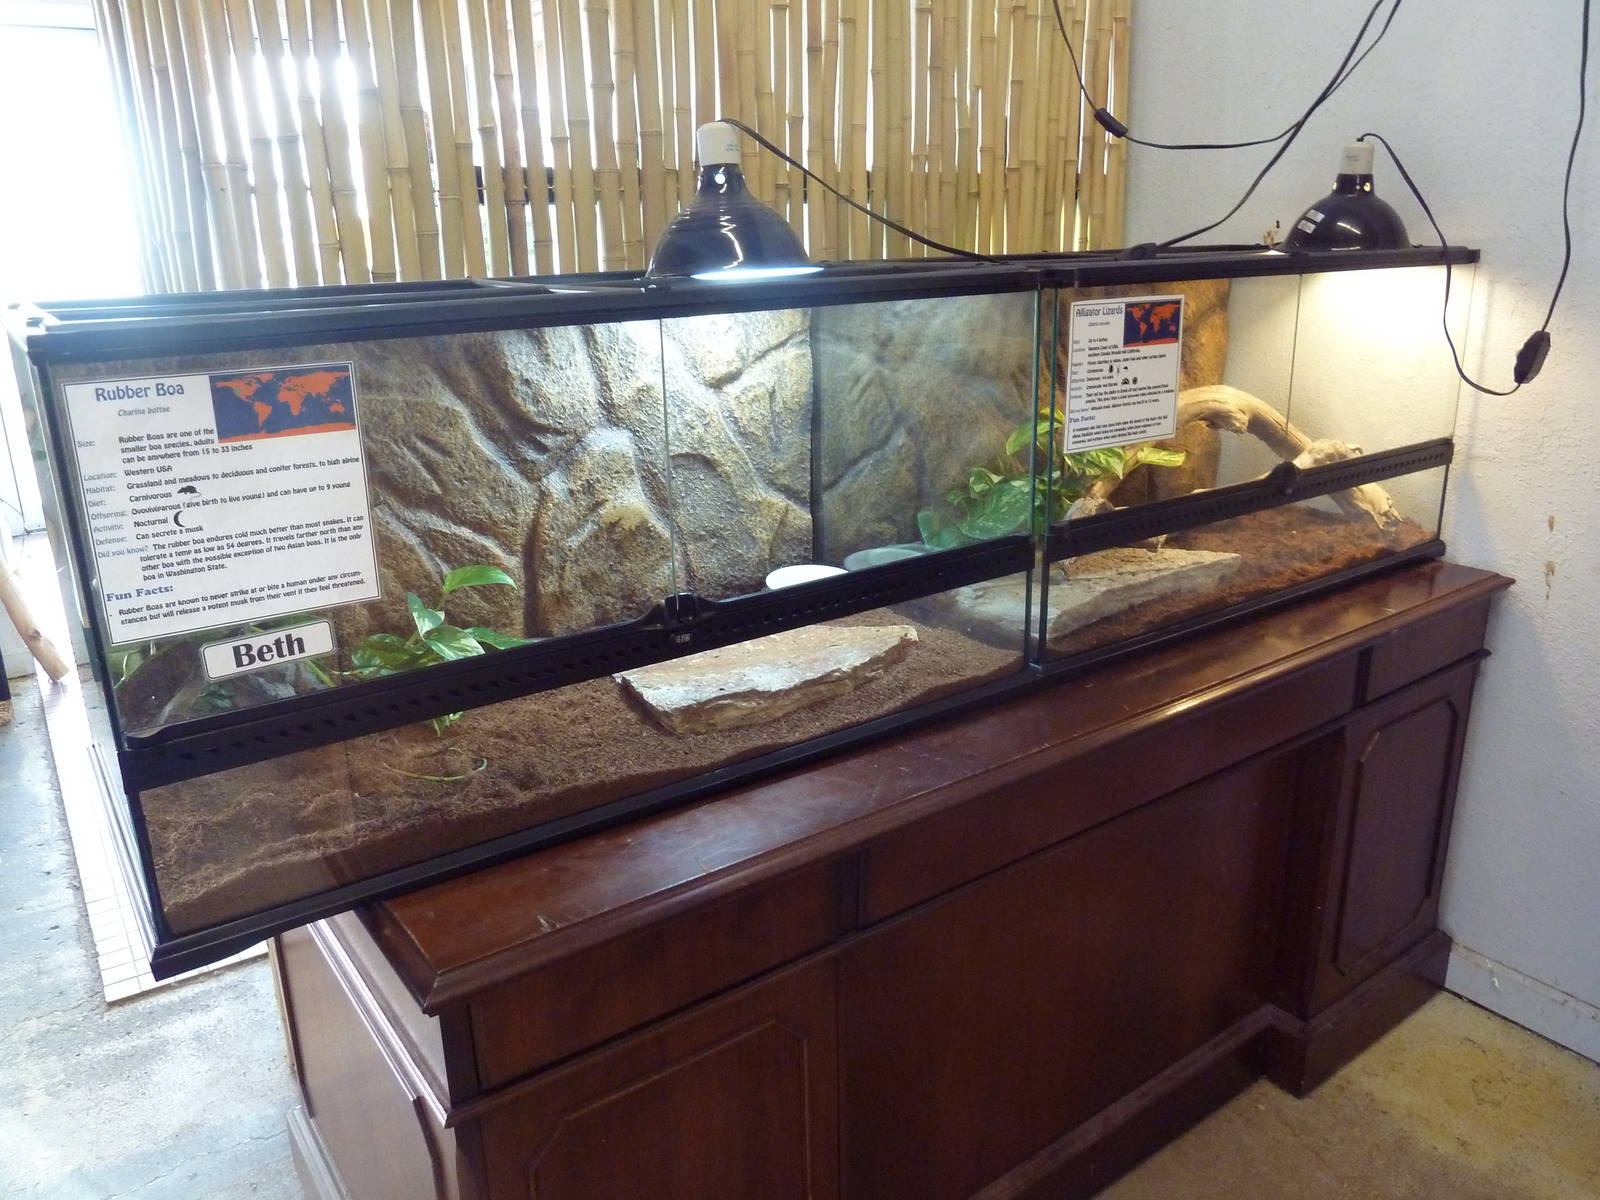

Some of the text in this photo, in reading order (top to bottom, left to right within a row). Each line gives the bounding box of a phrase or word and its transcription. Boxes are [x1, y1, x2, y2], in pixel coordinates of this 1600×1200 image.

[1076, 306, 1124, 318] Alligator Lizards
[96, 382, 184, 401] Rubber Boa
[119, 434, 144, 444] Rubber
[120, 444, 146, 454] smaller
[149, 443, 161, 451] boa
[194, 438, 214, 446] adults
[122, 456, 135, 464] can
[136, 454, 146, 462] be
[148, 450, 180, 462] anywhere
[182, 448, 200, 457] from
[232, 444, 252, 452] inches
[84, 465, 172, 481] Location: Western USA
[86, 485, 116, 494] Habitat:
[126, 480, 162, 490] Grassland
[164, 477, 176, 486] and
[178, 474, 210, 484] meadows
[220, 468, 254, 478] deciduous
[256, 466, 268, 474] and
[269, 464, 292, 473] conifer
[327, 458, 340, 466] high
[342, 456, 360, 465] alpine
[88, 492, 172, 508] Diet: Carnivorous
[202, 498, 218, 506] birth
[228, 495, 240, 503] live
[266, 490, 278, 498] and
[292, 486, 308, 494] have
[332, 482, 350, 490] young
[134, 517, 168, 528] Nocturnal
[98, 550, 110, 559] Did
[126, 545, 148, 554] know?
[152, 543, 166, 551] The
[168, 540, 190, 549] rubber
[192, 537, 204, 545] boa
[206, 534, 234, 544] endures
[235, 531, 248, 540] cold
[250, 528, 268, 537] much
[269, 526, 288, 534] better
[290, 524, 304, 532] than
[136, 533, 150, 541] Can
[152, 529, 178, 538] secrete
[185, 526, 204, 534] musk
[140, 553, 167, 562] tolerate
[175, 550, 192, 558] temp
[226, 542, 235, 550] 54
[273, 534, 295, 543] travels
[296, 530, 318, 540] farther
[320, 528, 336, 536] north
[142, 564, 160, 572] other
[162, 560, 174, 569] boa
[176, 558, 191, 566] with
[192, 556, 204, 564] the
[204, 552, 232, 562] possible
[233, 547, 264, 558] exception
[287, 542, 306, 550] Asian
[348, 532, 362, 541] only
[143, 573, 156, 582] boa
[158, 572, 164, 580] in
[166, 566, 206, 578] Washington
[106, 585, 174, 602] Fun Facts:
[118, 606, 144, 616] Rubber
[146, 603, 164, 612] Boas
[178, 597, 200, 607] known
[210, 592, 229, 601] never
[230, 588, 249, 598] strike
[267, 583, 280, 592] bite
[286, 580, 308, 588] human
[308, 576, 326, 584] under
[120, 616, 148, 626] stances
[149, 612, 161, 621] but
[162, 610, 174, 618] will
[176, 606, 201, 616] release
[208, 601, 229, 611] potent
[230, 598, 249, 607] musk
[250, 596, 266, 604] from
[266, 592, 282, 601] their
[319, 583, 330, 592] feel
[232, 633, 306, 669] Beth
